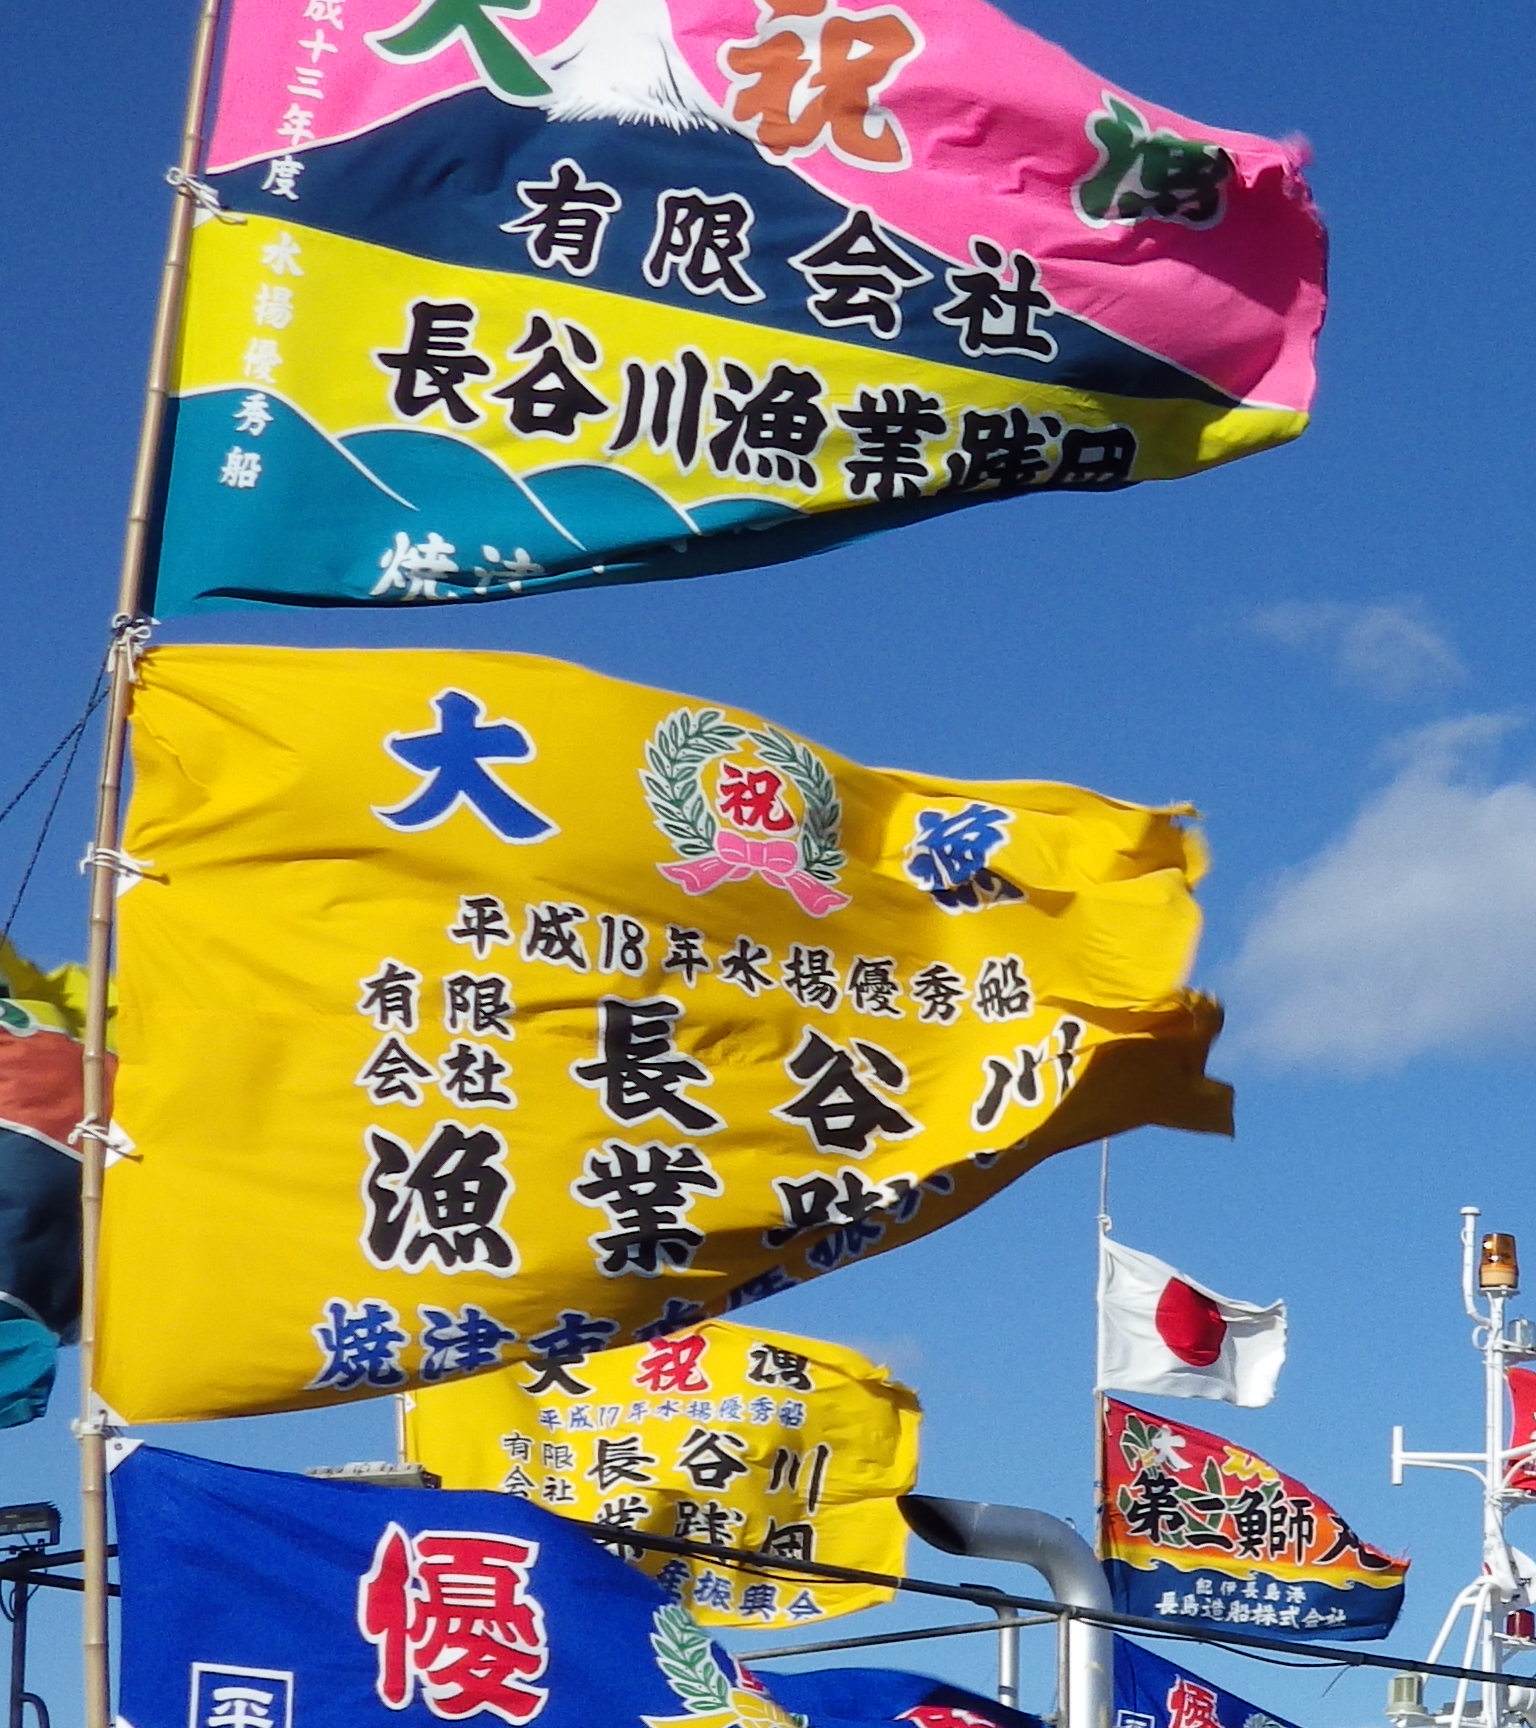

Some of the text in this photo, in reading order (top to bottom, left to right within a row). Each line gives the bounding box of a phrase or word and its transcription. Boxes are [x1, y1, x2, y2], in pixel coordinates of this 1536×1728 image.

[718, 0, 925, 170] 祝
[501, 157, 1056, 364] 有限会社
[372, 686, 560, 846] 大
[715, 760, 794, 834] 祝
[450, 895, 1032, 1023] 平成18年水揚優秀船
[521, 1355, 597, 1398] 大
[635, 1335, 713, 1398] 祝
[539, 1397, 807, 1431] 平成17年水揚優秀船
[587, 1427, 829, 1515] 長谷川
[356, 1521, 550, 1727] 優
[1155, 1590, 1348, 1630] 長島造船株式会社
